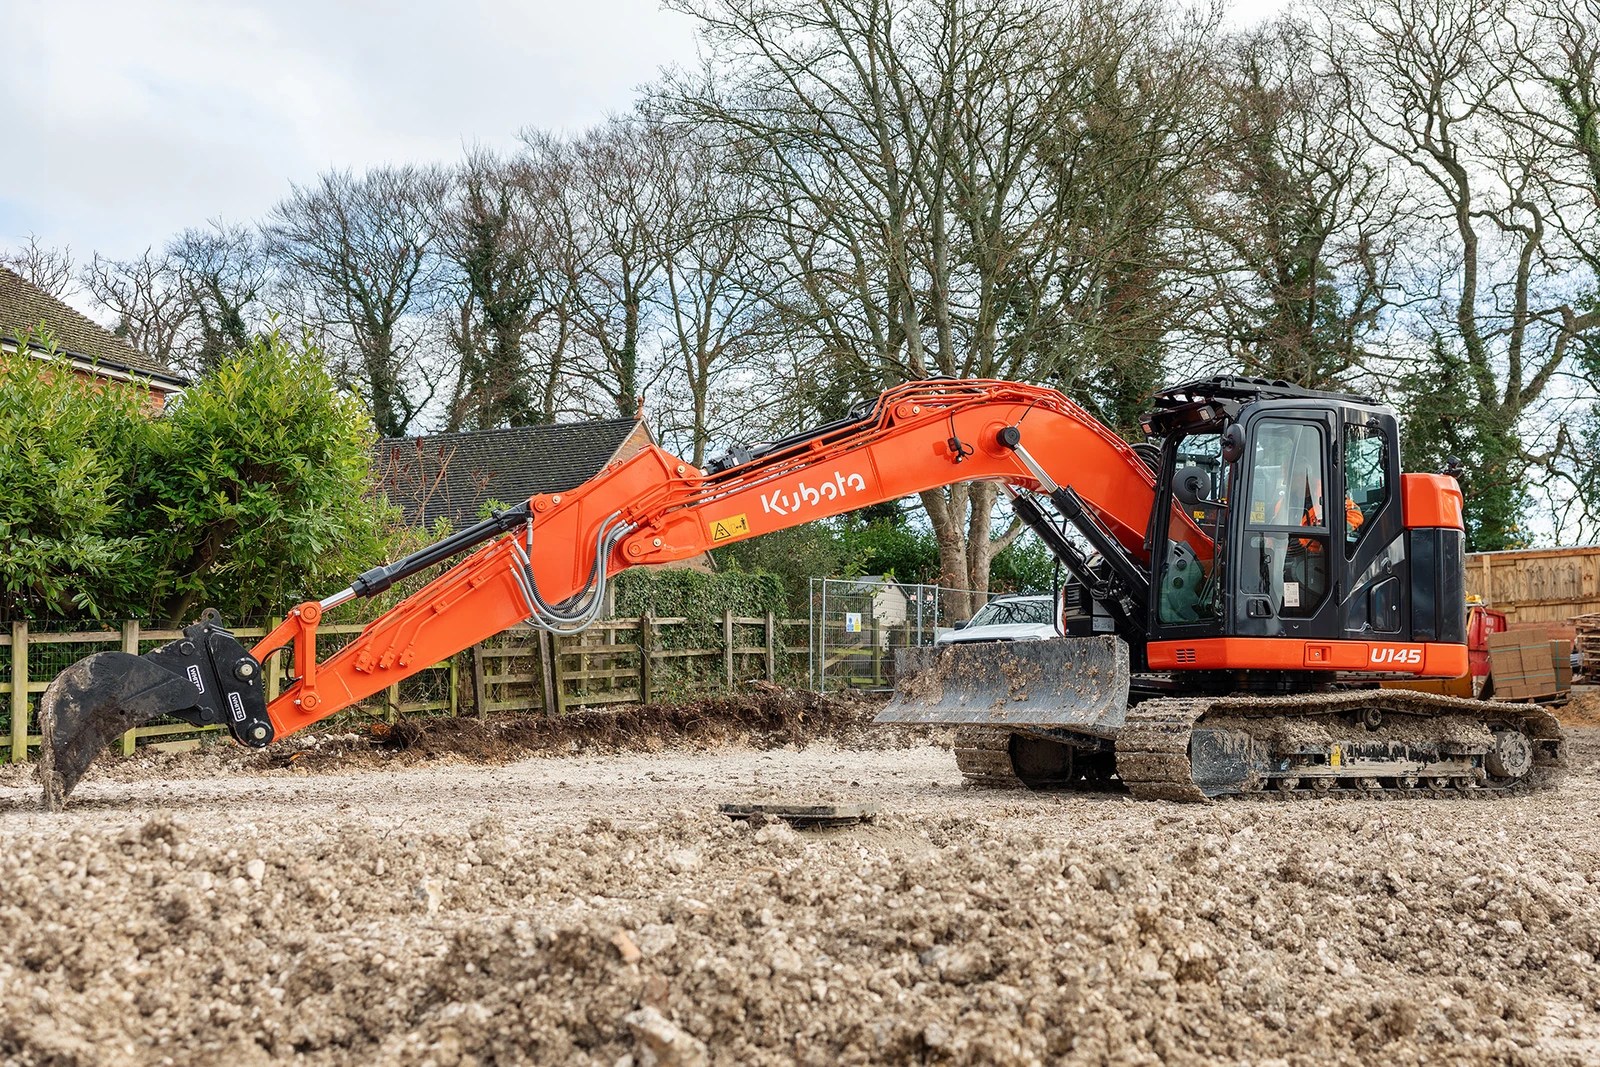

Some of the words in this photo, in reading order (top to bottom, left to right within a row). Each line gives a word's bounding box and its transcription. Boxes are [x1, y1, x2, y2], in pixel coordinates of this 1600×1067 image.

[760, 471, 866, 516] Kubota
[1371, 648, 1421, 663] U145
[231, 694, 243, 719] WHITES
